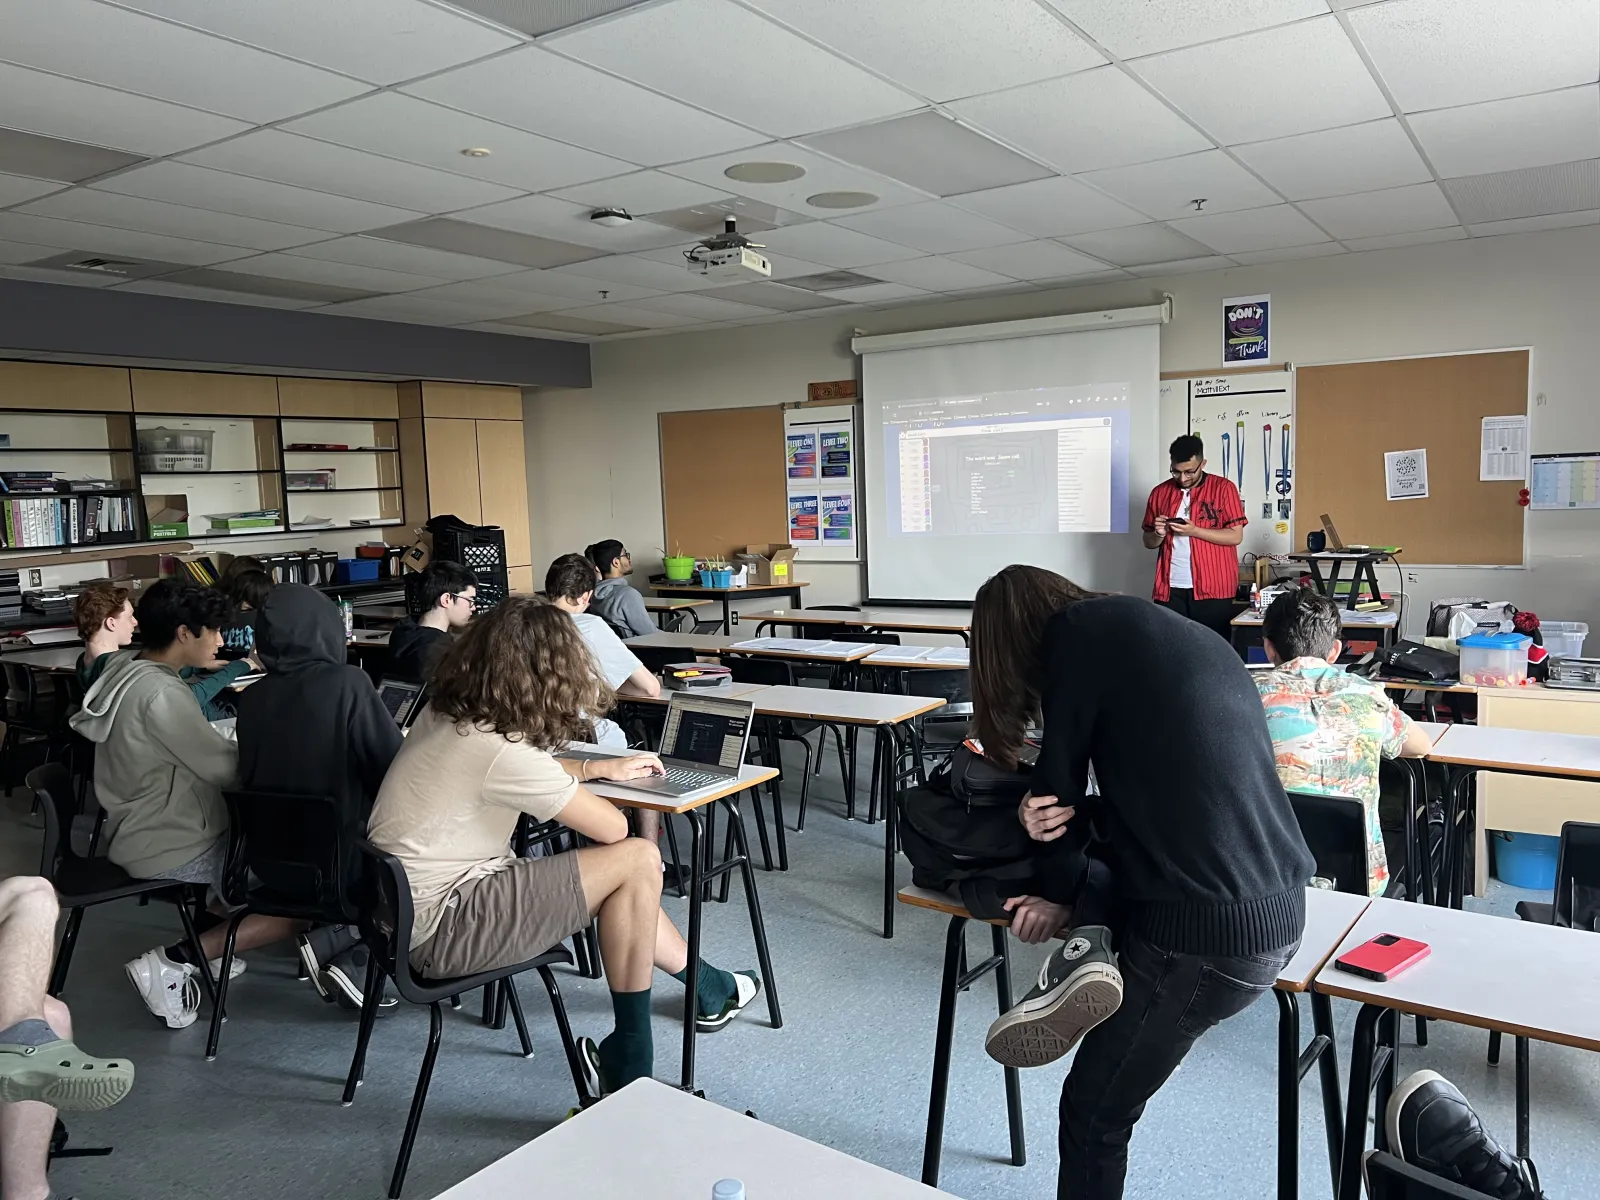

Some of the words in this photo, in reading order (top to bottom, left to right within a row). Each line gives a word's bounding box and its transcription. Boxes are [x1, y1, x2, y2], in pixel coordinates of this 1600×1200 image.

[1228, 306, 1264, 322] DON'T
[1236, 340, 1267, 358] Think!
[790, 439, 803, 448] LEVEL
[803, 437, 814, 446] ONE
[822, 438, 836, 448] LEVEL
[836, 436, 849, 445] TWO
[790, 501, 802, 509] LEVEL
[803, 500, 818, 508] THREE
[824, 500, 837, 509] LEVEL
[837, 498, 852, 508] FOUR
